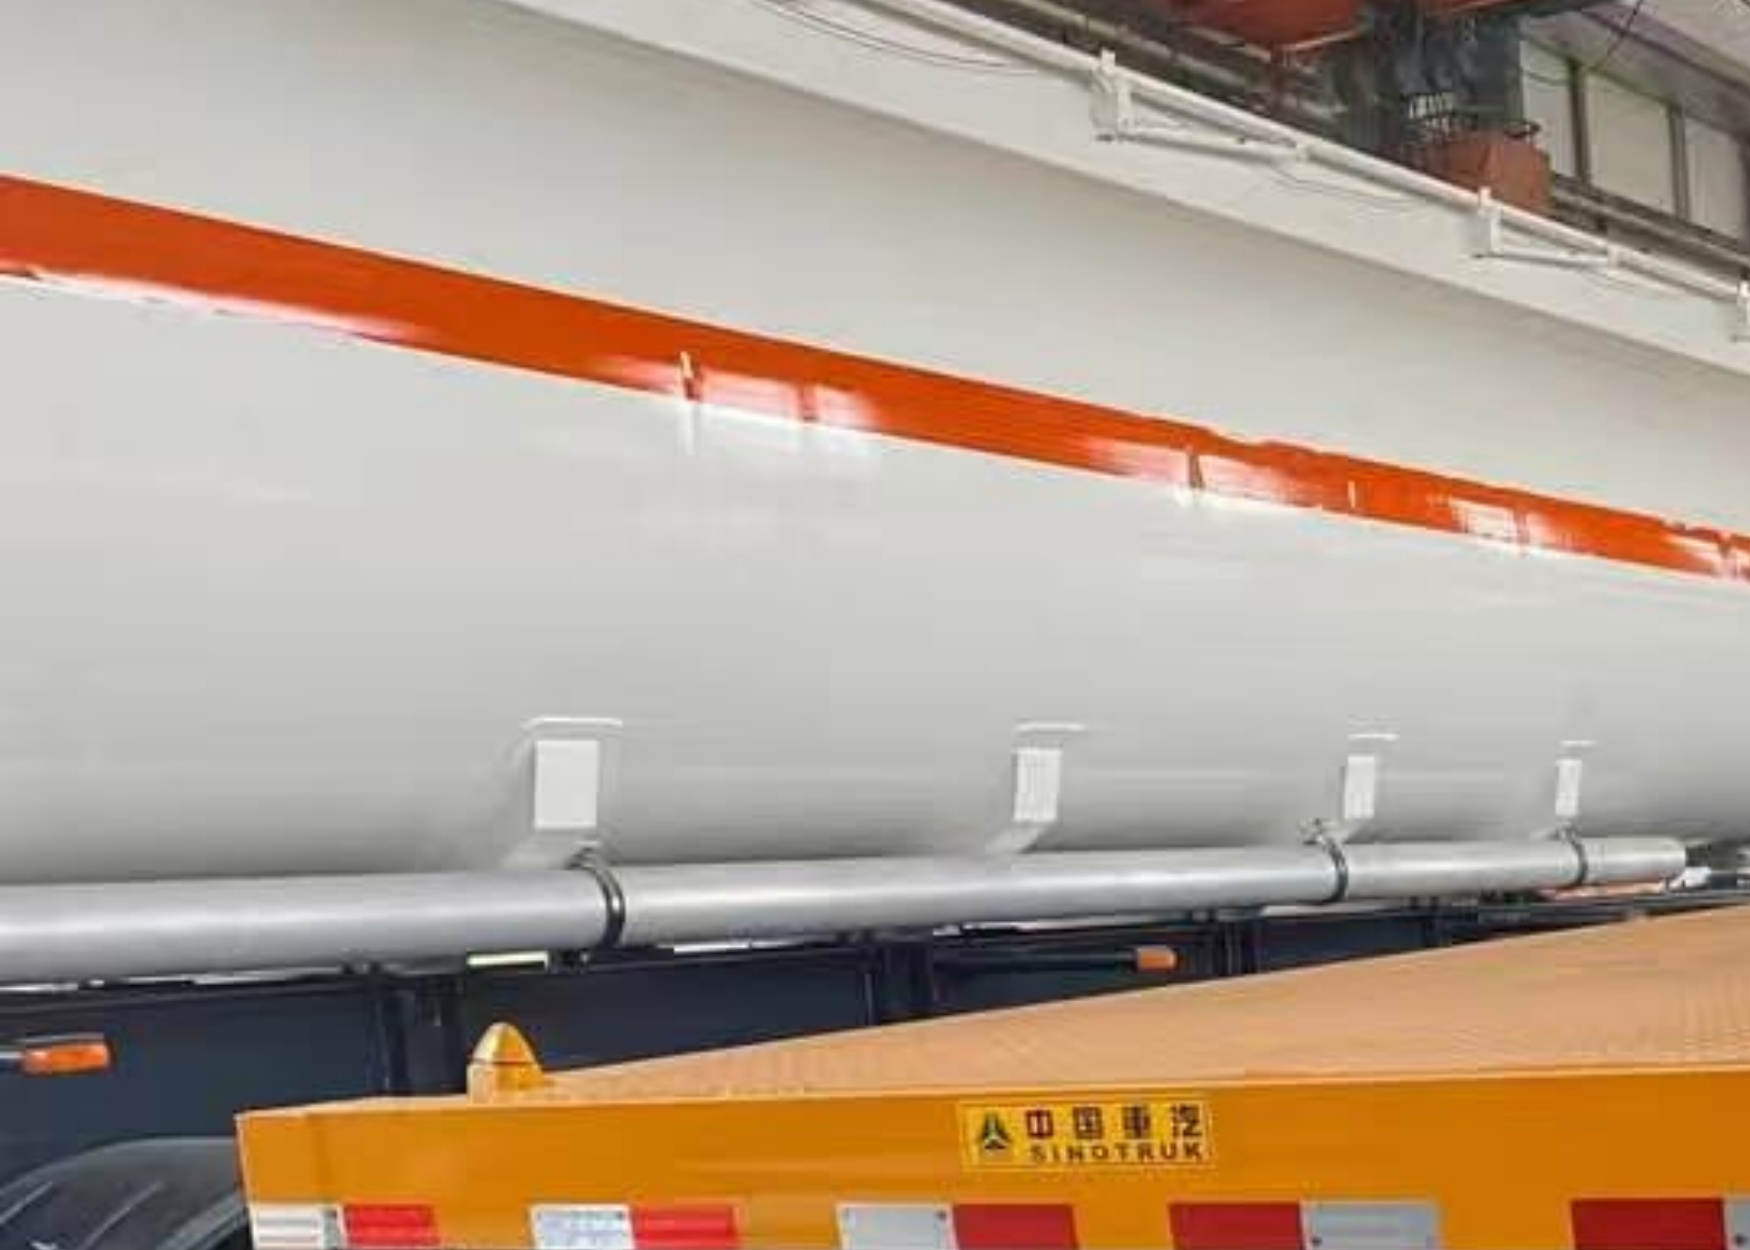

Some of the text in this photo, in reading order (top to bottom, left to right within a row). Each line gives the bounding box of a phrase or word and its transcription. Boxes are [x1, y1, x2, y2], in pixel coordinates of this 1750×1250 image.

[1026, 1104, 1203, 1140] 中国重汽
[1029, 1143, 1204, 1163] SINOTRUK
